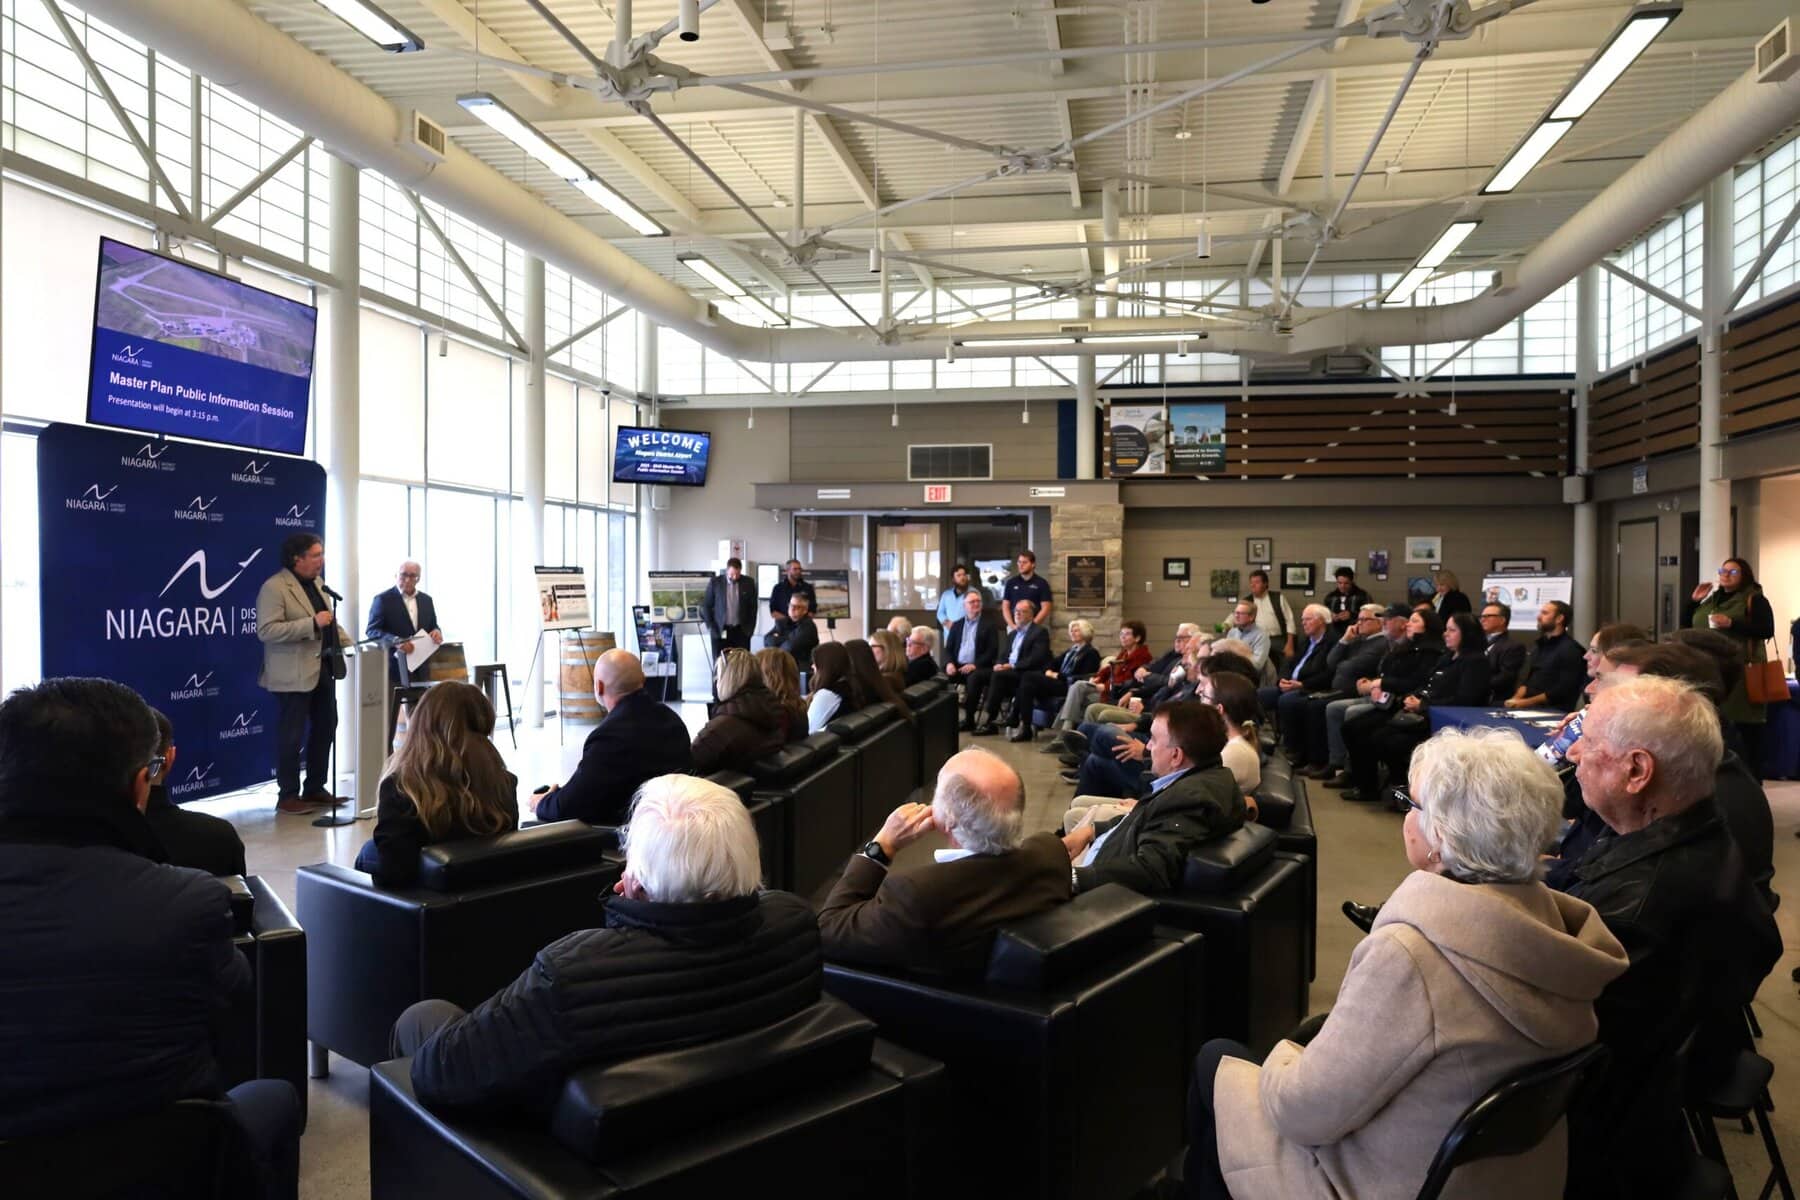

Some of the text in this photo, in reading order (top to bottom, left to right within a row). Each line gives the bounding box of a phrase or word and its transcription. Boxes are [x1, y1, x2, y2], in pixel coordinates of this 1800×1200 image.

[111, 353, 139, 366] NIAGARA
[109, 371, 294, 419] Master Plan Public Information Session
[108, 394, 220, 423] Presentation will begin at 3:15 p.m.
[627, 432, 704, 454] WELCOME
[121, 455, 158, 470] NIAGARA
[231, 472, 261, 484] NIAGARA
[928, 486, 946, 501] EXIT
[65, 499, 106, 512] NIAGARA
[174, 510, 207, 522] NIAGARA
[275, 517, 302, 528] NIAGARA
[240, 607, 257, 620] DIS
[106, 606, 227, 641] NIAGARA
[240, 622, 257, 634] AIR
[170, 688, 203, 700] NIAGARA
[219, 727, 249, 740] NIAGARA
[172, 782, 204, 795] NIAGARA
